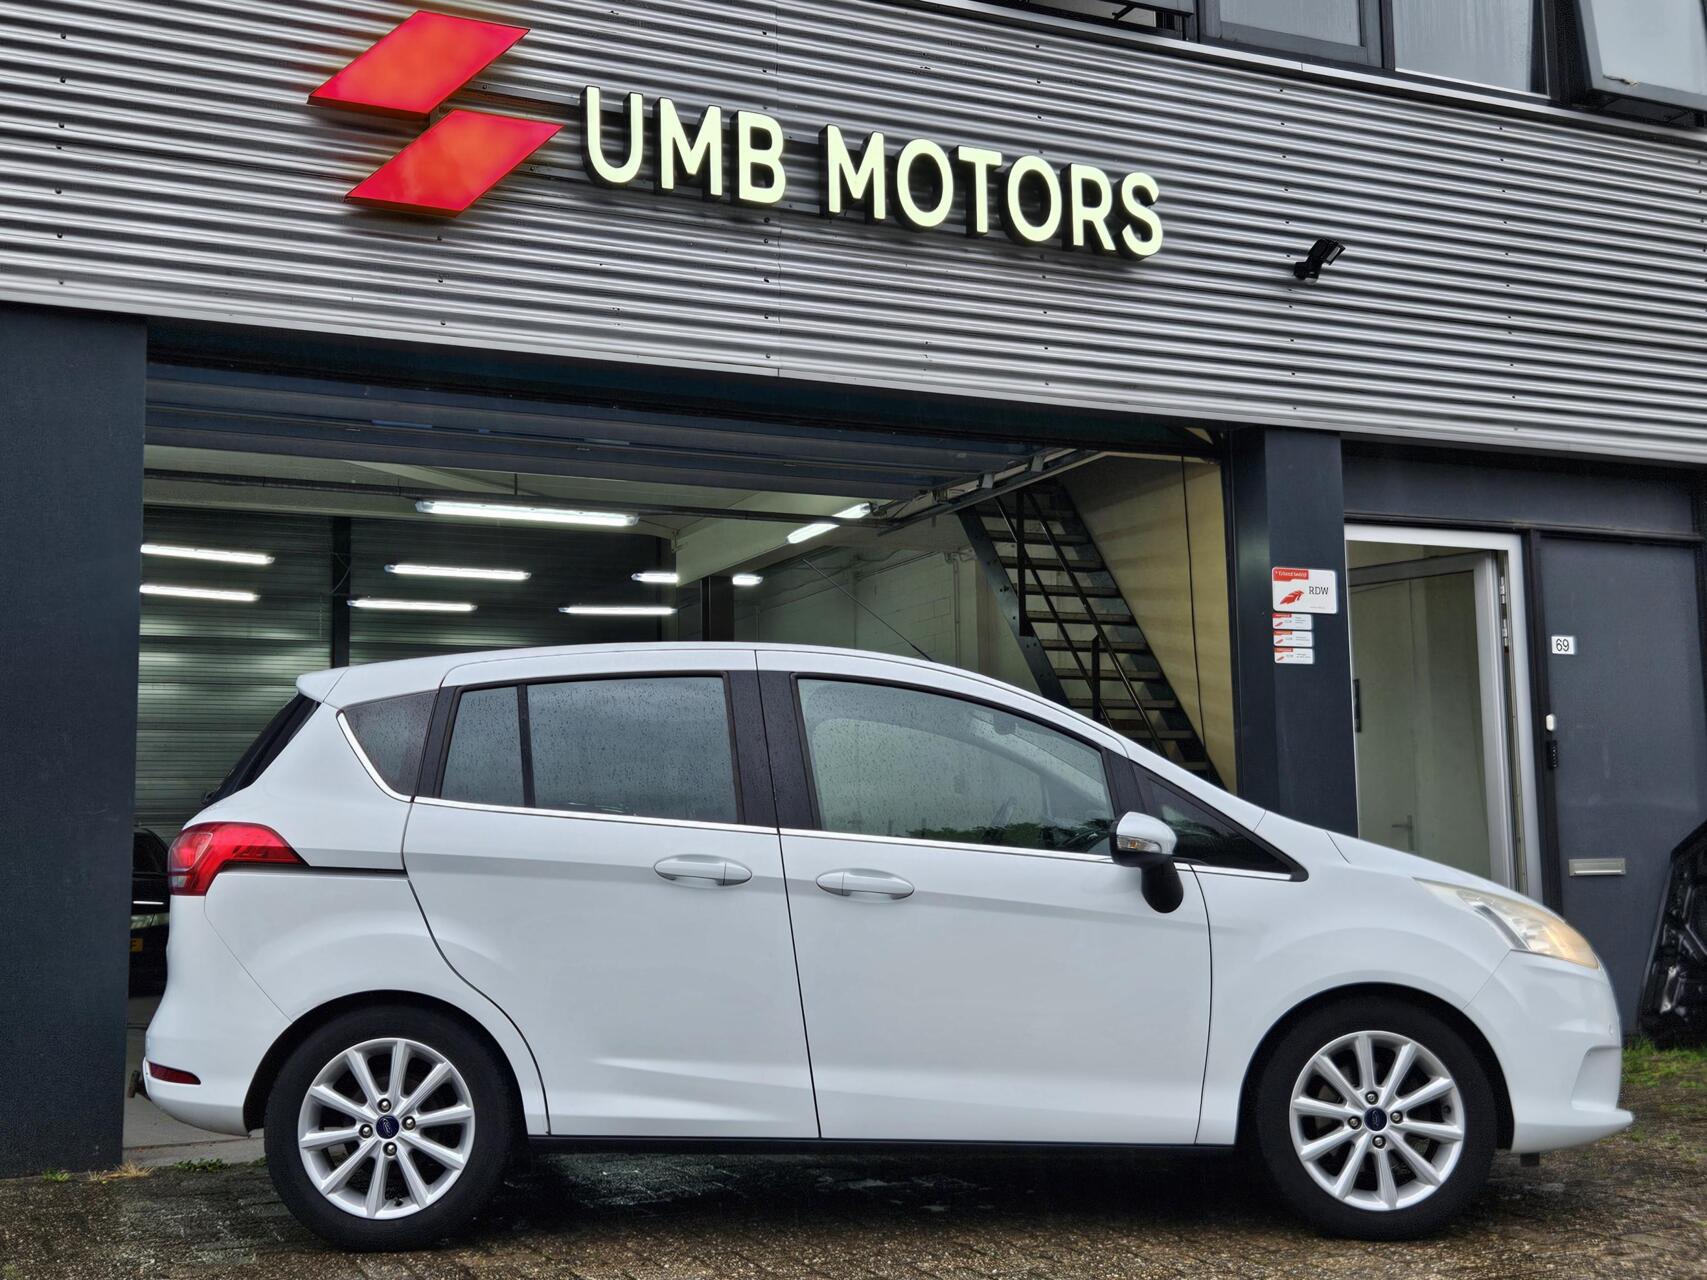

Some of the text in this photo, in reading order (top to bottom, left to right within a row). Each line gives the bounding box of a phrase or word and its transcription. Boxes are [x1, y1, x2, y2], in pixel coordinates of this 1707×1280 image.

[583, 84, 1164, 258] UMB MOTORS
[1308, 585, 1329, 595] RDW
[1556, 638, 1570, 652] 69
